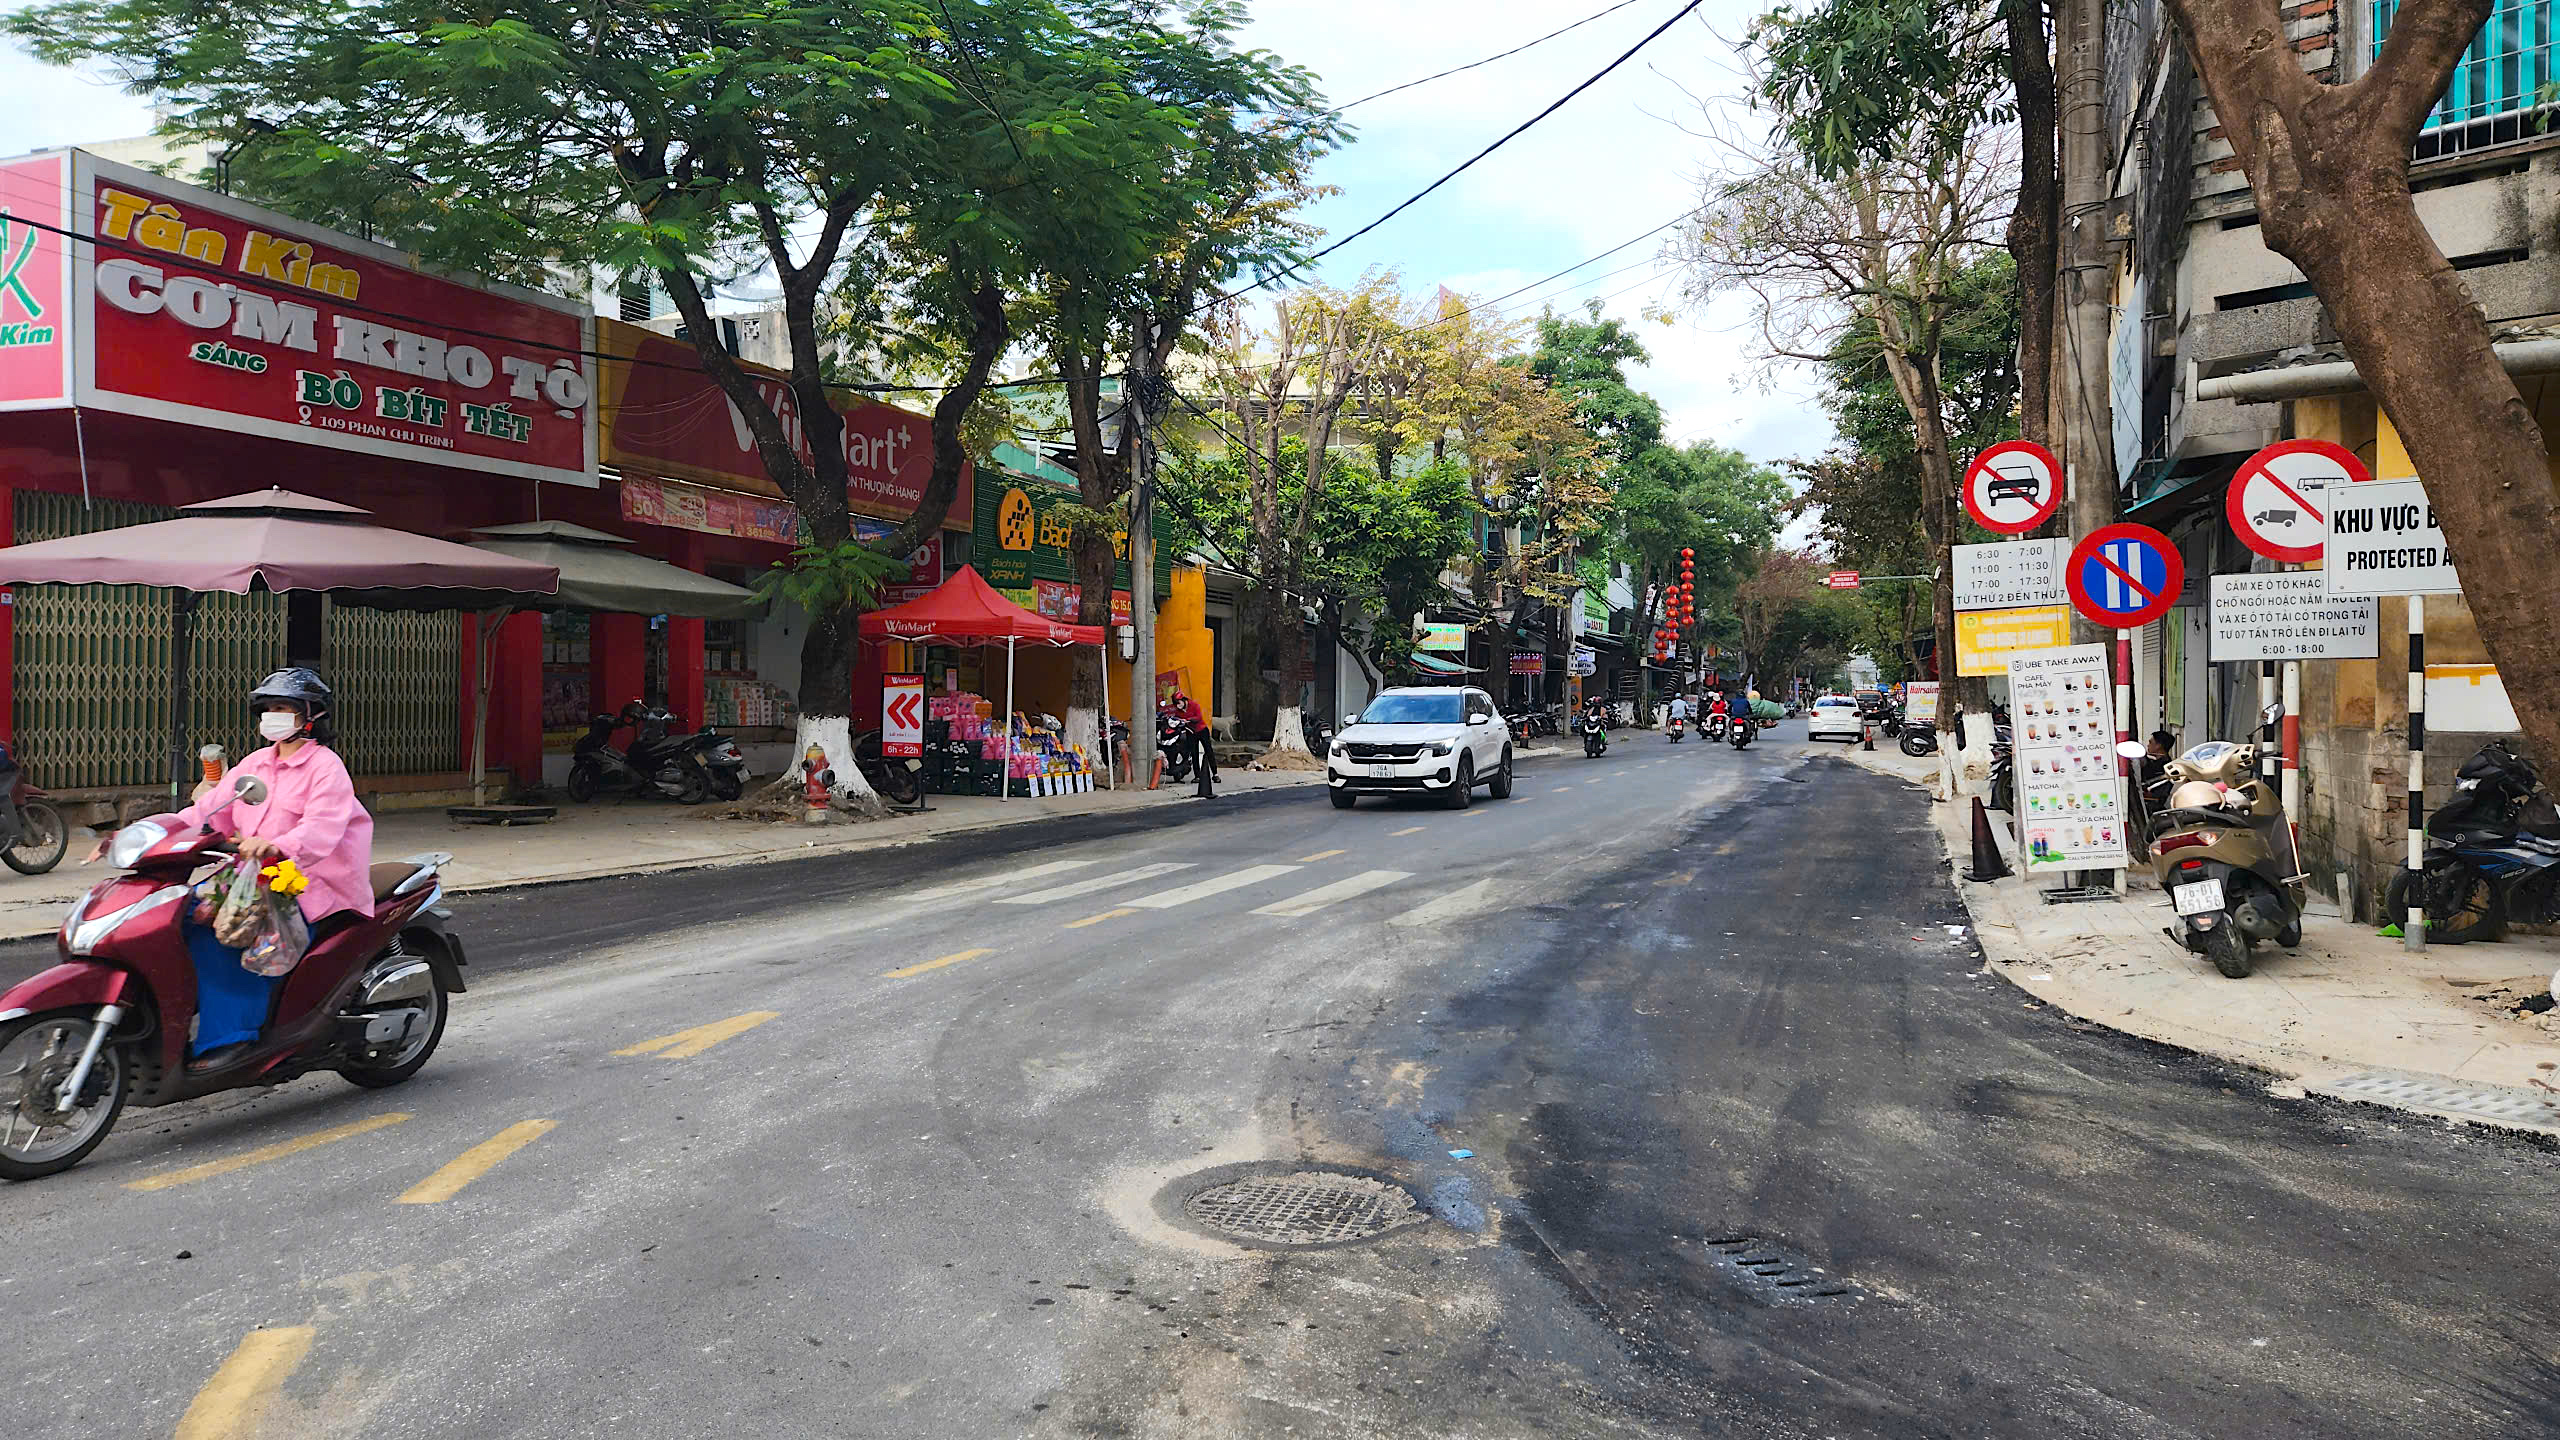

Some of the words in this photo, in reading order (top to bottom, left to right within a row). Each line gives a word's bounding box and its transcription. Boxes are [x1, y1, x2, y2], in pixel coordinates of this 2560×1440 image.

[99, 188, 227, 266] Tân
[240, 230, 361, 301] Kim
[97, 259, 318, 353] CƠM
[334, 314, 493, 388] KHO
[503, 355, 588, 418] TỘ
[189, 341, 267, 374] SÁNG
[296, 369, 362, 410] BÒ
[376, 385, 447, 428] BÍT
[461, 402, 532, 444] TẾT
[320, 416, 346, 430] 109
[349, 421, 387, 437] PHAN
[390, 428, 414, 442] CHU
[2334, 508, 2373, 534] KHU
[2380, 504, 2420, 536] VỰC
[1976, 549, 2000, 560] 6:30
[2019, 546, 2042, 556] 7:00
[2347, 547, 2437, 571] PROTECTED
[1971, 564, 2000, 574] 11:00
[2019, 561, 2048, 571] 11:30
[990, 569, 1025, 580] XANH
[1971, 579, 2000, 589] 17:00
[2020, 576, 2049, 586] 17:30
[2250, 581, 2263, 590] XE
[2292, 577, 2324, 589] KHÁC
[1998, 594, 2004, 602] 2
[2059, 590, 2066, 598] 7
[2234, 614, 2247, 623] XE
[2312, 610, 2349, 623] TRỌNG
[2352, 606, 2369, 620] TẢI
[2235, 630, 2246, 639] 07
[2319, 627, 2329, 636] ĐI
[2332, 627, 2349, 638] LẠI
[2262, 645, 2285, 654] 6:00
[2295, 644, 2325, 654] 18:00
[2045, 658, 2069, 667] TAKE
[2072, 656, 2101, 665] AWAY
[903, 746, 919, 754] 22h
[2028, 783, 2060, 791] MATCHA
